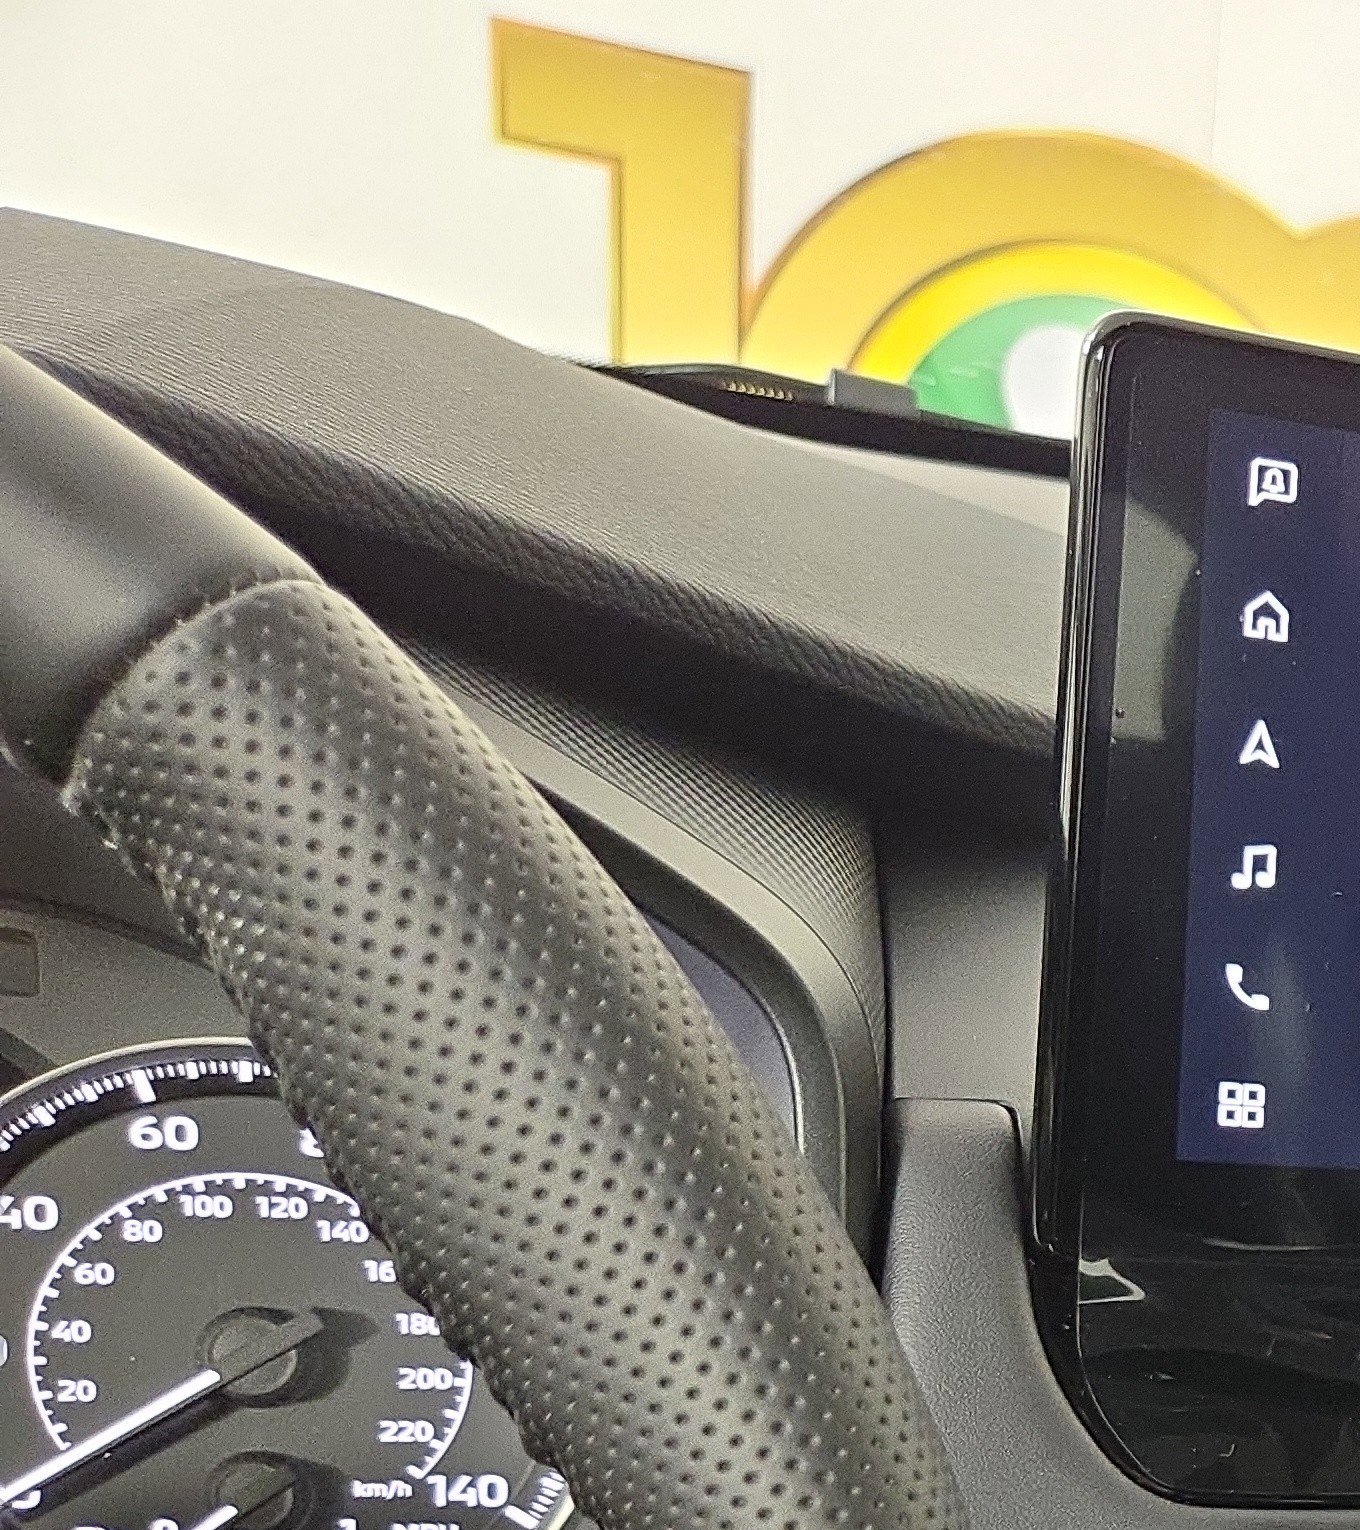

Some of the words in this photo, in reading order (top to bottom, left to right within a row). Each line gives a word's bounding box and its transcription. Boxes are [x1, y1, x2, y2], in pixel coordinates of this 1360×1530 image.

[128, 1115, 200, 1151] 60
[0, 1195, 60, 1231] 40
[179, 1194, 234, 1219] 100
[255, 1196, 309, 1220] 120
[122, 1219, 163, 1243] 80
[315, 1219, 370, 1243] 140
[73, 1262, 116, 1286] 60
[363, 1259, 397, 1283] 16
[51, 1319, 92, 1343] 40
[57, 1379, 97, 1402] 20
[397, 1367, 454, 1391] 200
[378, 1419, 435, 1443] 220
[351, 1478, 413, 1500] km/h
[426, 1473, 509, 1508] 140
